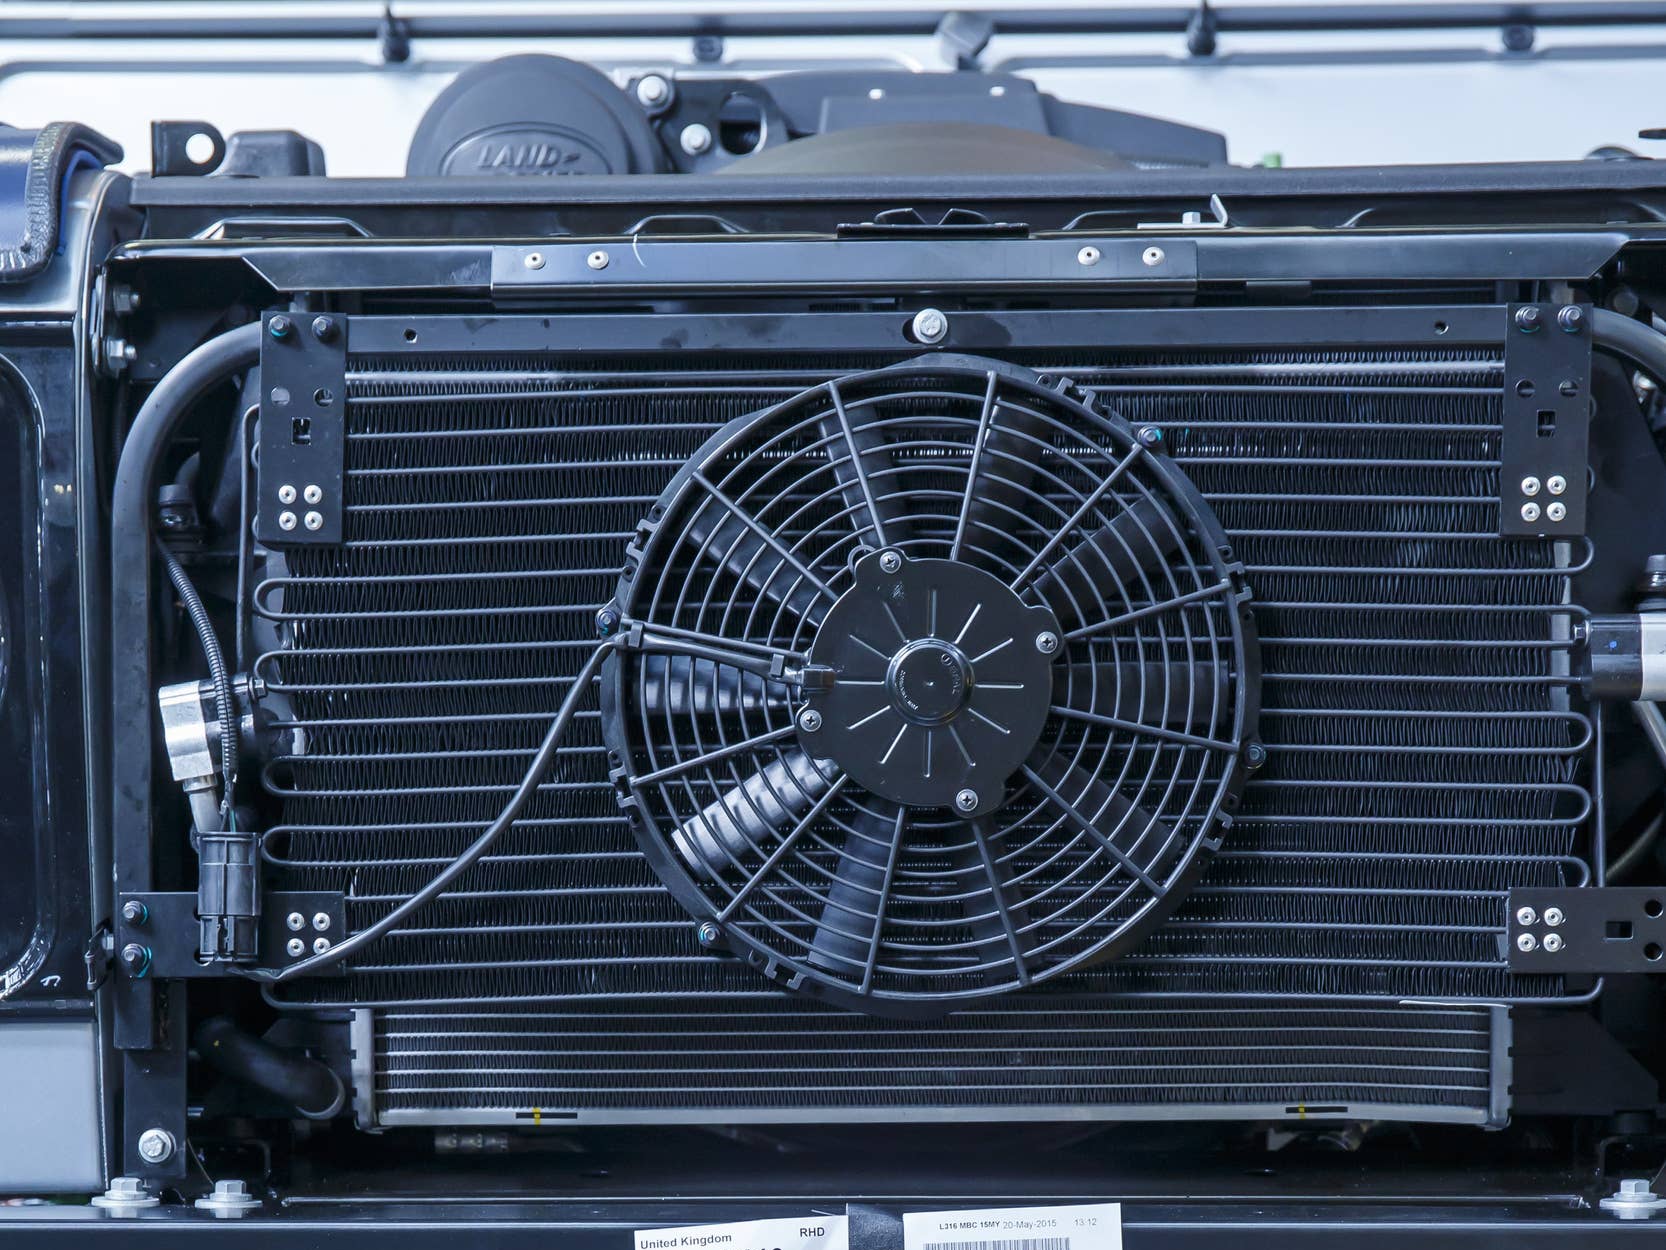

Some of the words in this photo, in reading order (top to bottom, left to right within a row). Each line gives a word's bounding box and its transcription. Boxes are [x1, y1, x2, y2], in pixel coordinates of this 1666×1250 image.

[478, 143, 564, 170] LAND
[1003, 1219, 1056, 1230] 20-May-2015
[800, 1227, 825, 1237] RHD
[641, 1238, 677, 1249] United
[681, 1235, 732, 1247] Kingdom
